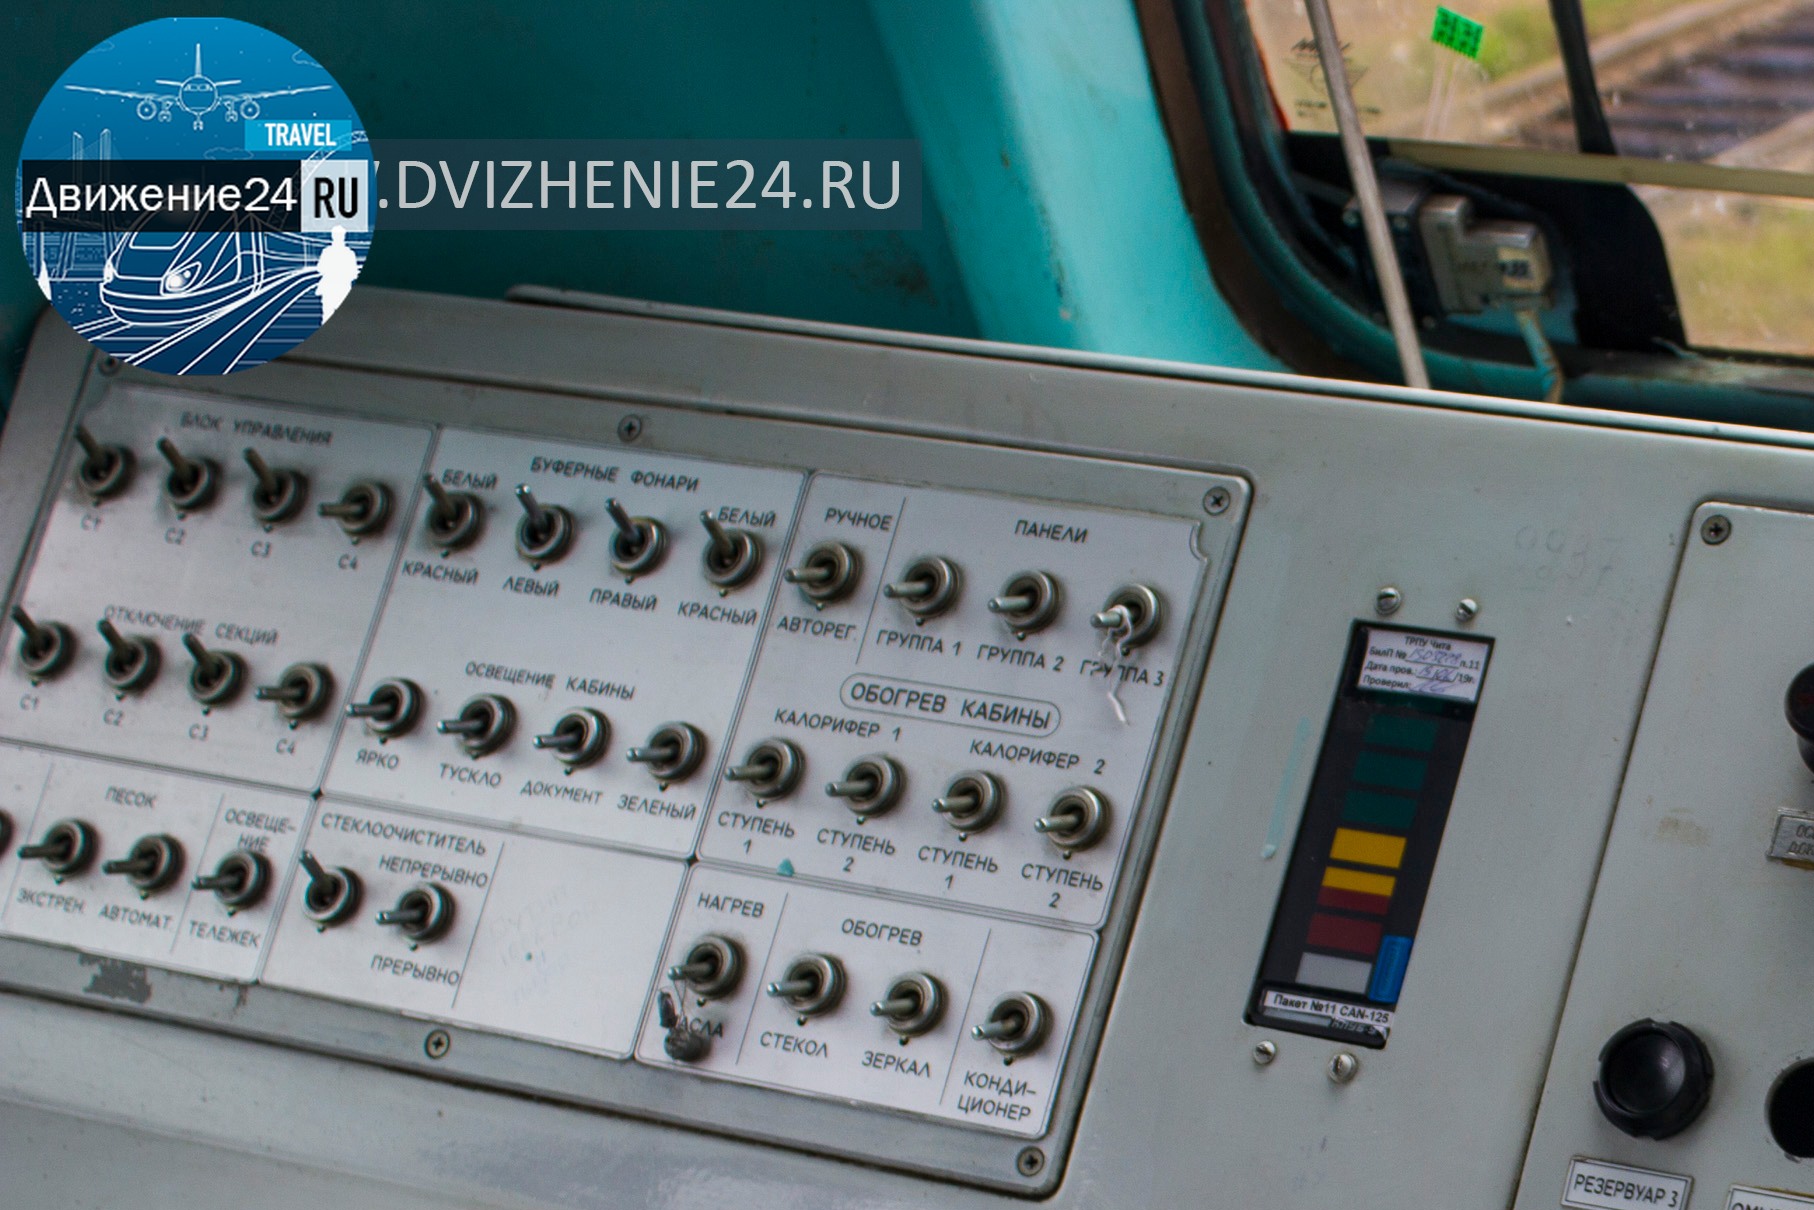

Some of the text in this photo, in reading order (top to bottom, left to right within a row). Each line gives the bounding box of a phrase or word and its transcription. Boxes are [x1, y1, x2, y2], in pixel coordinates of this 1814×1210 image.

[179, 410, 333, 446] БЛОК УПРАВЛЕНИЯ
[441, 467, 498, 490] БЕЛЫЙ
[530, 455, 699, 492] БУФЕРНЫЕ ФОНАРИ
[717, 505, 777, 528] БЕЛЫЙ
[824, 506, 894, 531] РУЧНОЕ
[1013, 518, 1089, 544] ПАНЕЛИ
[401, 559, 479, 586] КРАСНЫЙ
[502, 575, 560, 598] ЛЕВЫЙ
[589, 587, 659, 613] ПРАВЫЙ
[677, 600, 758, 628] КРАСНЫЙ
[214, 622, 279, 646] СЕКЦИЙ
[876, 628, 962, 656] ГРУППА 1
[976, 642, 1065, 672] ГРУППА 2
[465, 660, 637, 700] ОСВЕЩЕНИЕ КАБИНЫ
[1153, 670, 1165, 686] 3
[850, 680, 1052, 730] ОБОГРЕВ КАБИНЫ
[773, 707, 902, 742] КАЛОРИФЕР 1
[355, 747, 400, 771] ЯРКО
[968, 739, 1106, 775] КАЛОРИФЕР 2
[439, 763, 502, 788] ТУСКЛО
[105, 785, 157, 810] ПЕСОК
[520, 779, 604, 805] ДОКУМЕНТ
[616, 793, 697, 822] ЗЕЛЕНЫЙ
[321, 813, 488, 857] СТЕКЛООЧИСТИТЕЛЬ
[717, 811, 796, 839] СТУПЕНЬ
[237, 833, 269, 853] НИЕ
[742, 838, 753, 855] 1
[816, 828, 897, 856] СТУПЕНЬ
[378, 854, 489, 889] НЕПРЕРЫВНО
[842, 856, 855, 873] 2
[917, 844, 999, 873] СТУПЕНЬ
[943, 873, 954, 890] 1
[1020, 862, 1104, 892] СТУПЕНЬ
[697, 891, 766, 918] НАГРЕВ
[1048, 891, 1061, 909] 2
[188, 919, 262, 949] ТЕЛЕЖЕК
[840, 917, 924, 947] ОБОГРЕВ
[370, 954, 461, 987] ПРЕРЫВНО
[1273, 993, 1390, 1024] Пакет №11 CAN-125
[759, 1030, 829, 1059] СТЕКОЛ
[861, 1049, 931, 1078] ЗЕРКАЛ
[963, 1070, 1037, 1098] КОНДИ-
[957, 1093, 1032, 1122] ЦИОНЕР
[1573, 1172, 1679, 1208] РЕЗЕРВУАР 3
